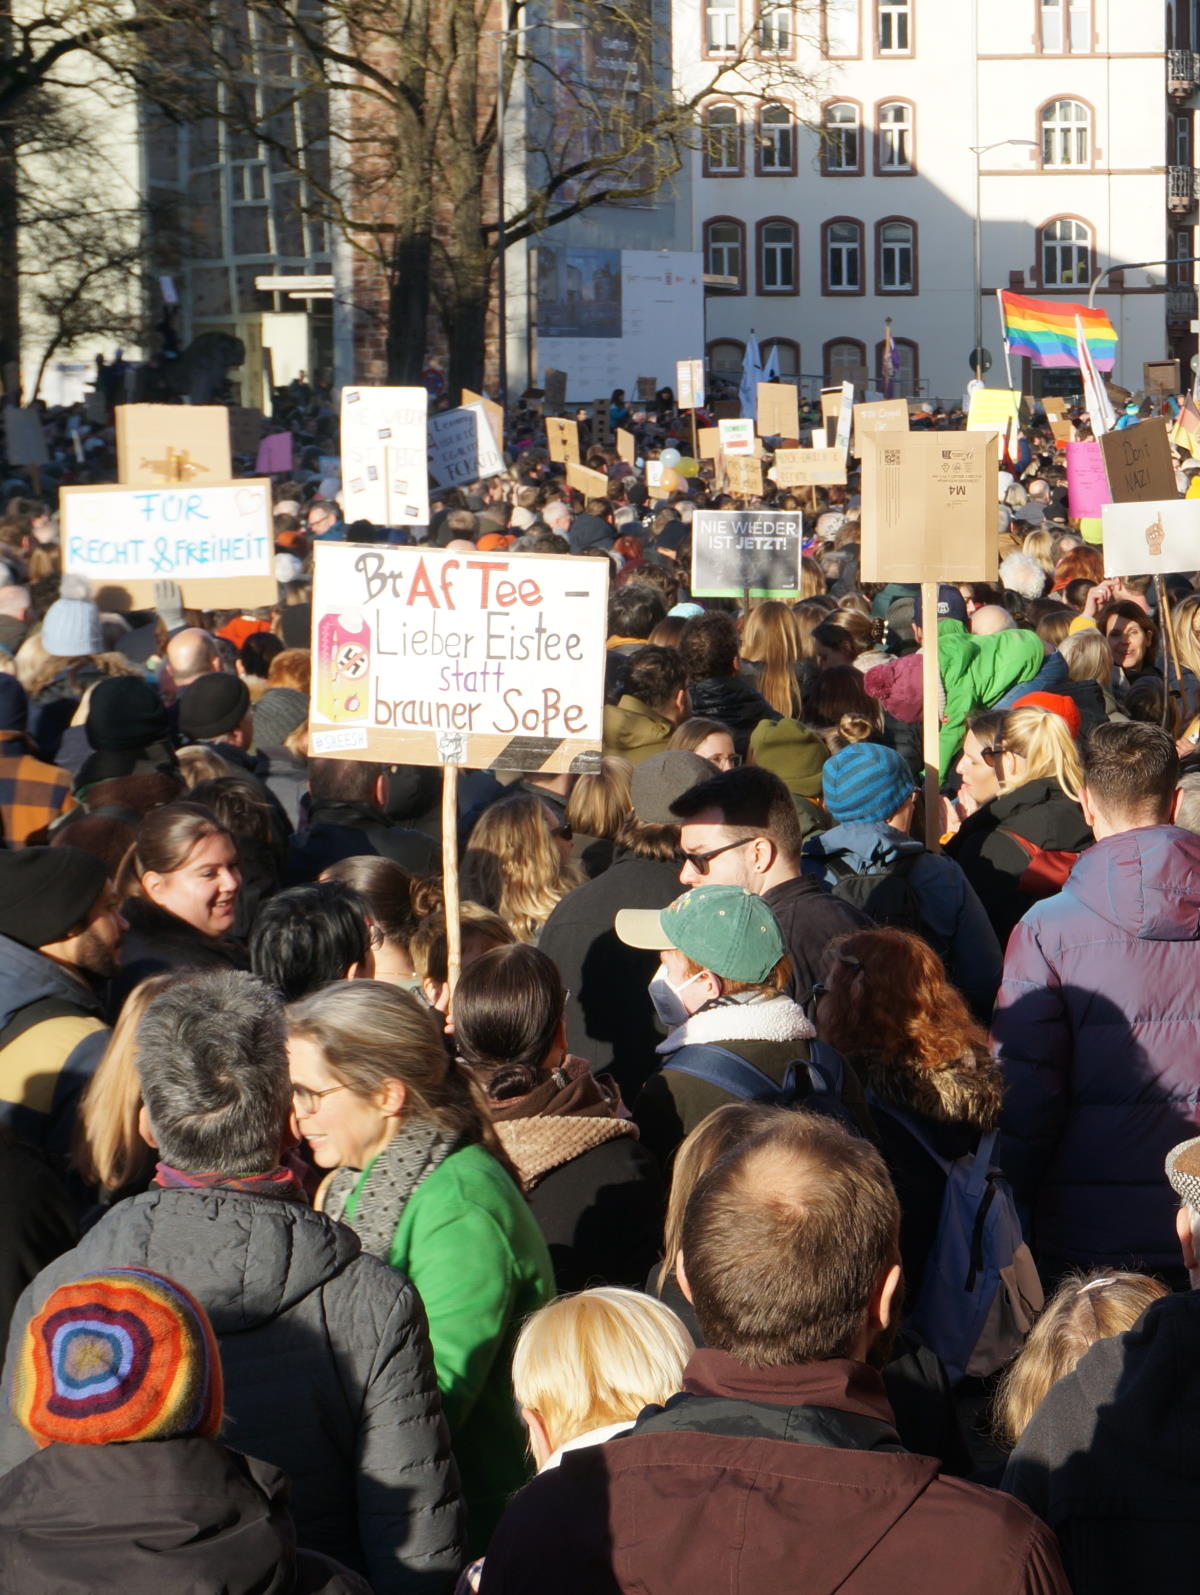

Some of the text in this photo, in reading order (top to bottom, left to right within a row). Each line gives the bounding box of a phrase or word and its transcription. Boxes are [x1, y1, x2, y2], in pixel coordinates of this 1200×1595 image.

[948, 485, 967, 496] M4
[132, 493, 210, 523] FÜR
[700, 519, 797, 535] NIE WIEDER
[69, 536, 145, 566] RECHT
[708, 536, 788, 551] IST JETZT!
[375, 608, 475, 659] Lieber
[485, 611, 584, 662] Eistee
[438, 659, 505, 694] statt
[374, 675, 483, 732] brauner
